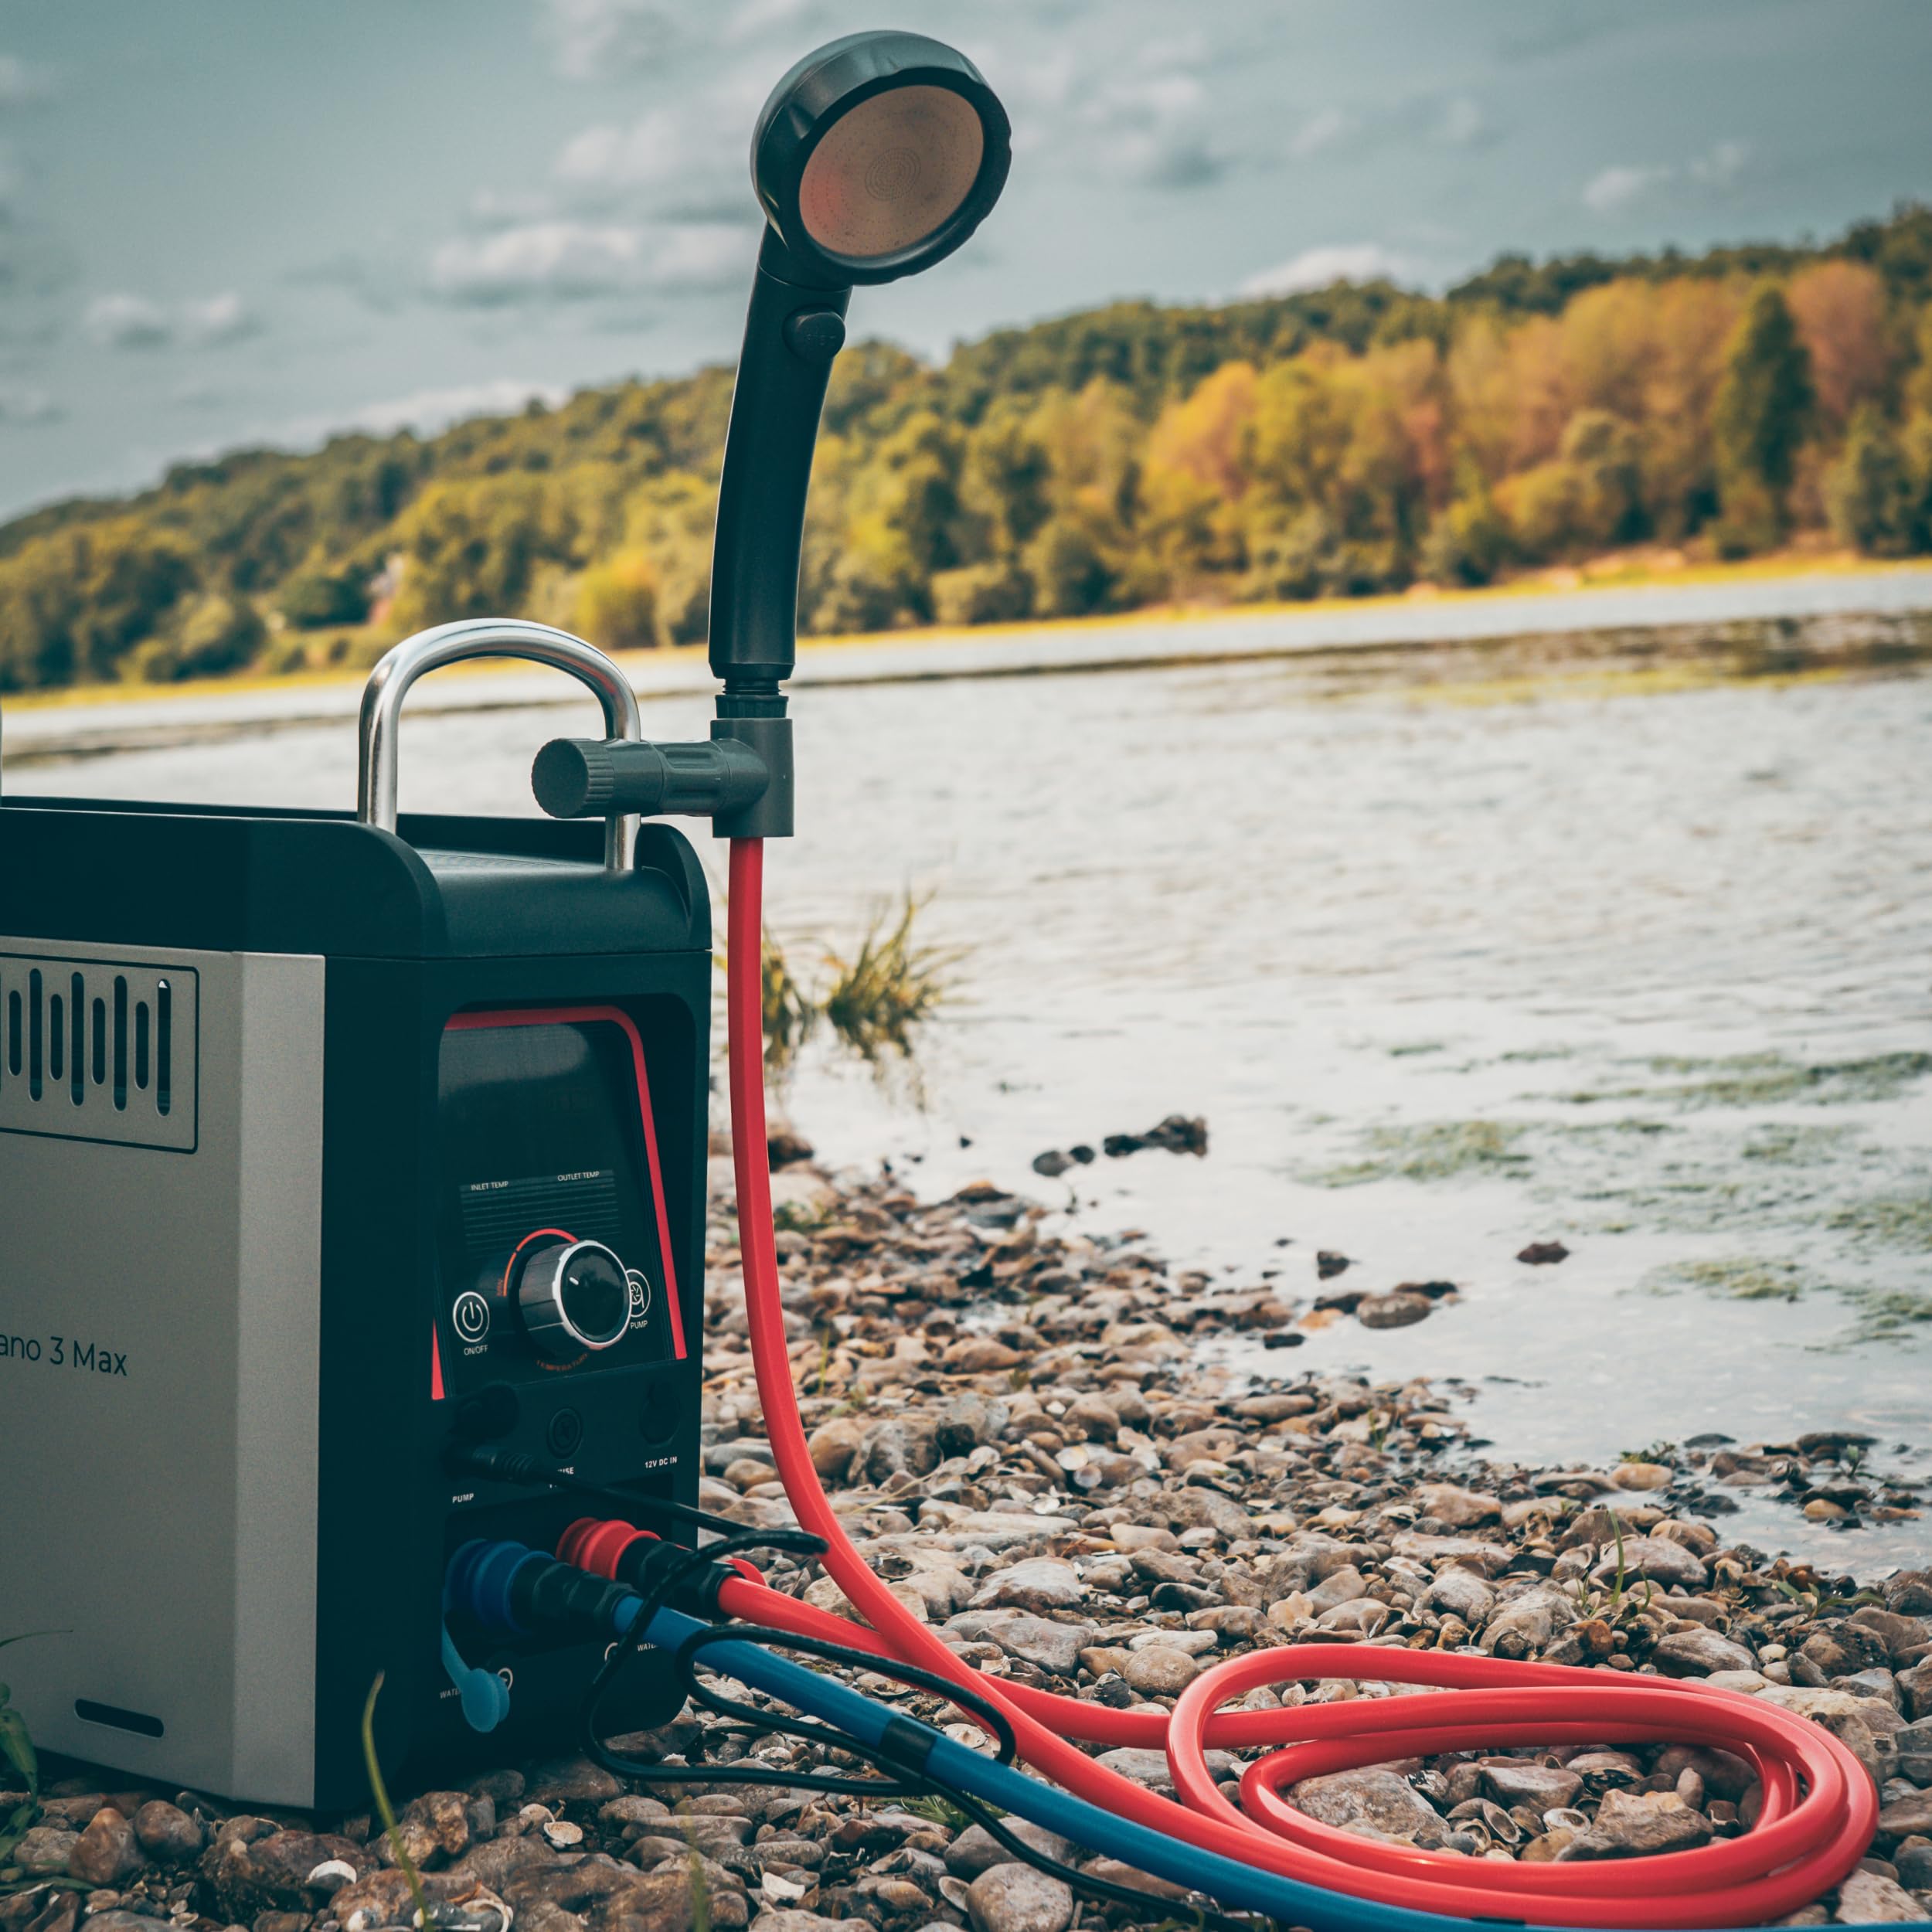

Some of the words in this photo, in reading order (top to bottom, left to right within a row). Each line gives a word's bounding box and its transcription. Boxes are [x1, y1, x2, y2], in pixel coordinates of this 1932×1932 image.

[557, 1172, 581, 1181] OUTLET
[630, 1320, 648, 1329] PUMP
[49, 1336, 63, 1365] 3
[73, 1340, 127, 1376] Max
[645, 1460, 657, 1468] 12V
[658, 1458, 668, 1466] DC
[452, 1492, 474, 1503] PUMP
